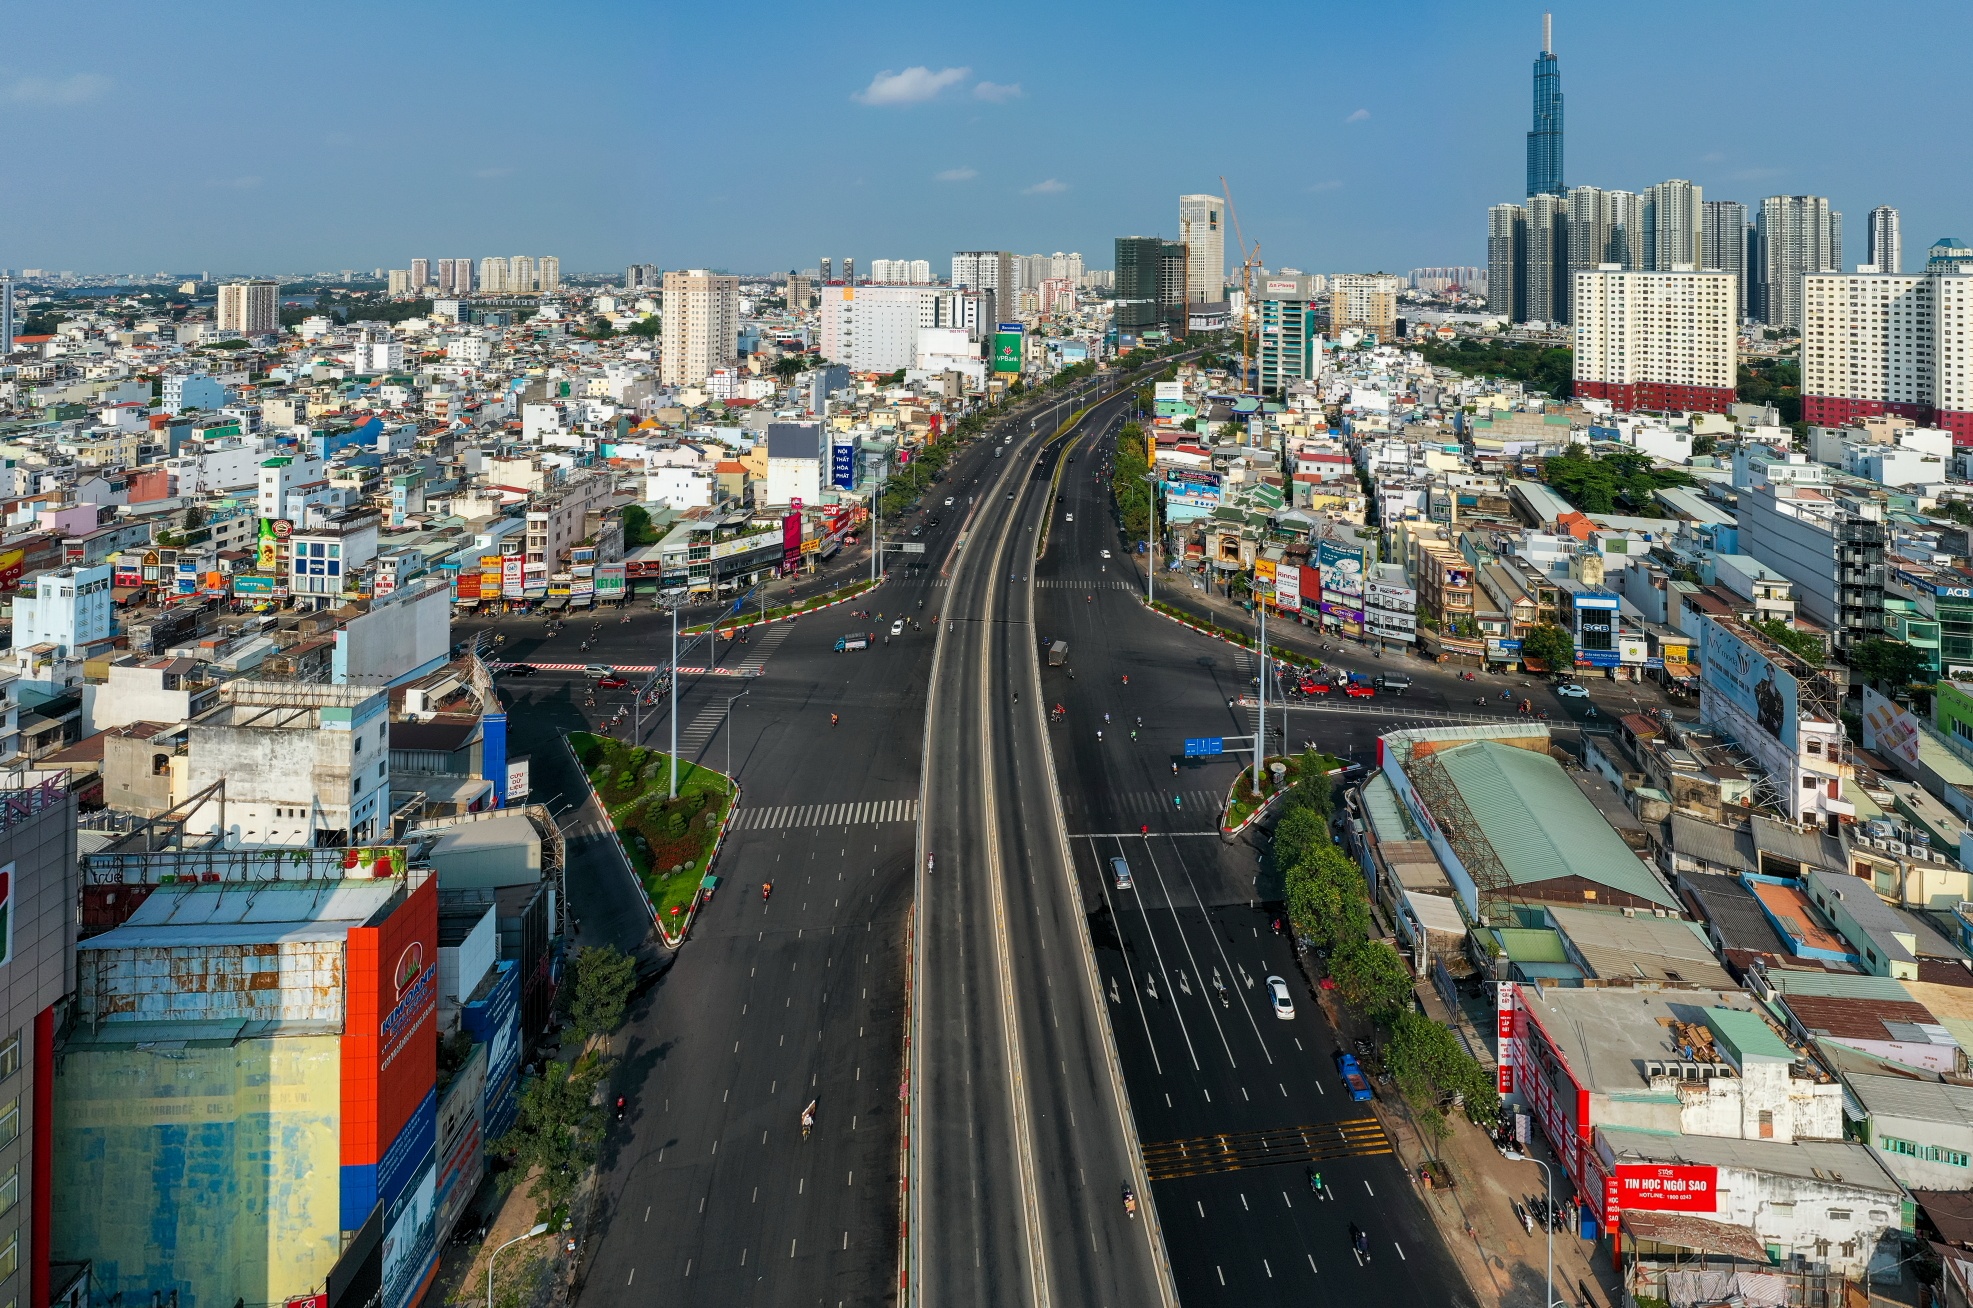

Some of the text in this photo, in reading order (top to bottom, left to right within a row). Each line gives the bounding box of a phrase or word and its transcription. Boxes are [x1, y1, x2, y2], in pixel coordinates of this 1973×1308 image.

[610, 574, 623, 588] SẮT
[1278, 572, 1298, 580] Rinnai
[1946, 588, 1970, 598] ACB
[1583, 624, 1610, 632] SCB
[1708, 635, 1722, 654] IVY
[93, 871, 122, 884] true
[381, 962, 436, 1036] KIM OANH
[136, 1104, 195, 1116] CAMBRIDGE
[206, 1104, 223, 1114] CIE
[1624, 1178, 1707, 1192] TIN HỌC NGÔI SAO
